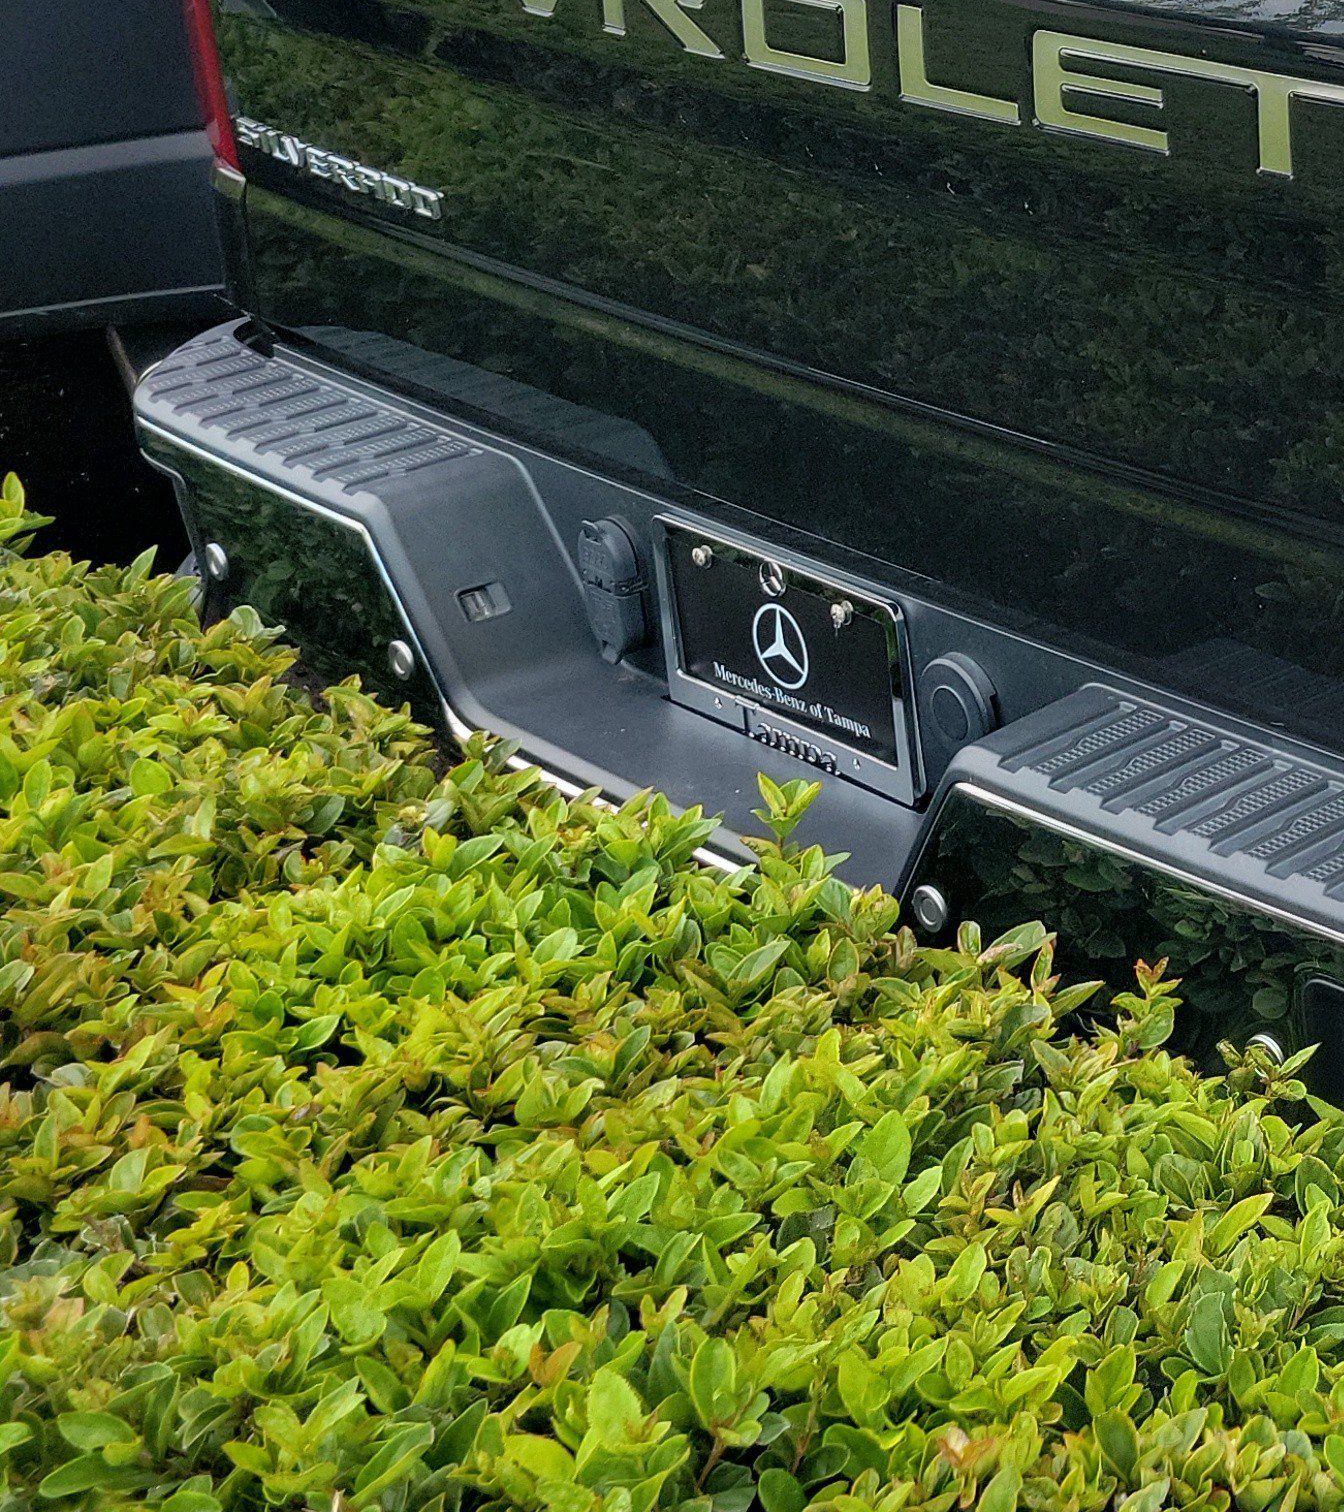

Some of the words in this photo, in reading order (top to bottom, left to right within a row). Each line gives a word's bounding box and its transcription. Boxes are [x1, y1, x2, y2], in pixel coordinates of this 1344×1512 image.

[235, 116, 445, 220] SILVERADO
[713, 661, 808, 713] Mercedes-Benz
[809, 703, 824, 719] of
[823, 706, 872, 739] Tampa
